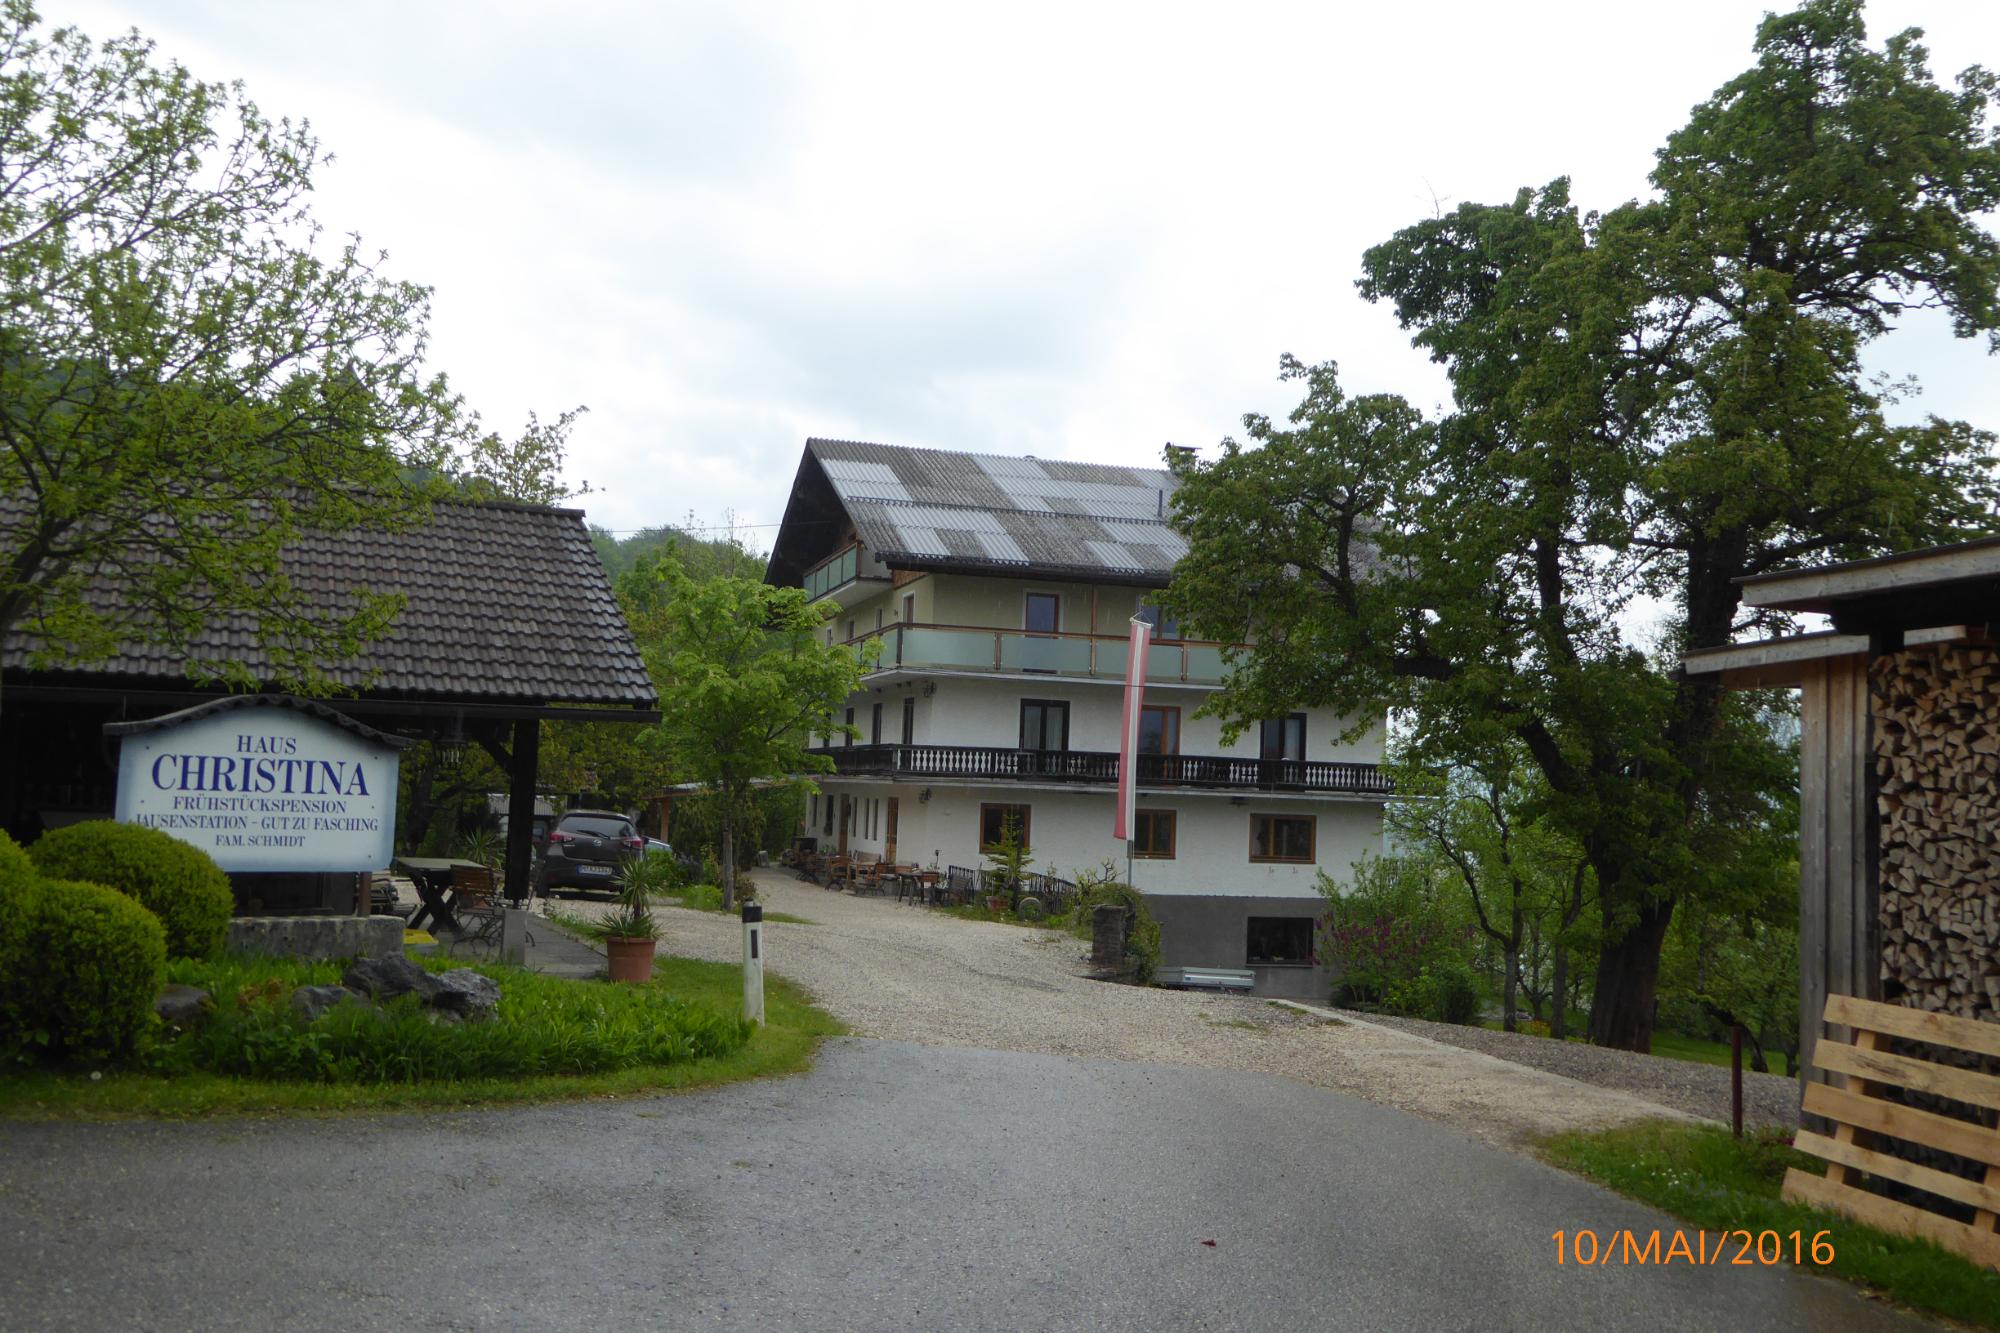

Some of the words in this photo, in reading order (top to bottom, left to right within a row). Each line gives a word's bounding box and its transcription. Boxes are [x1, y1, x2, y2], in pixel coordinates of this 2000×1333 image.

[236, 735, 297, 754] HAUS
[151, 753, 370, 796] CHRISTINA
[173, 793, 347, 814] FRÜHSTÜCKSPENSION
[261, 816, 290, 830] GUT
[292, 817, 310, 830] ZU
[314, 818, 378, 831] FASCHING
[215, 834, 245, 847] FAM.
[248, 835, 306, 848] SCHMIDT
